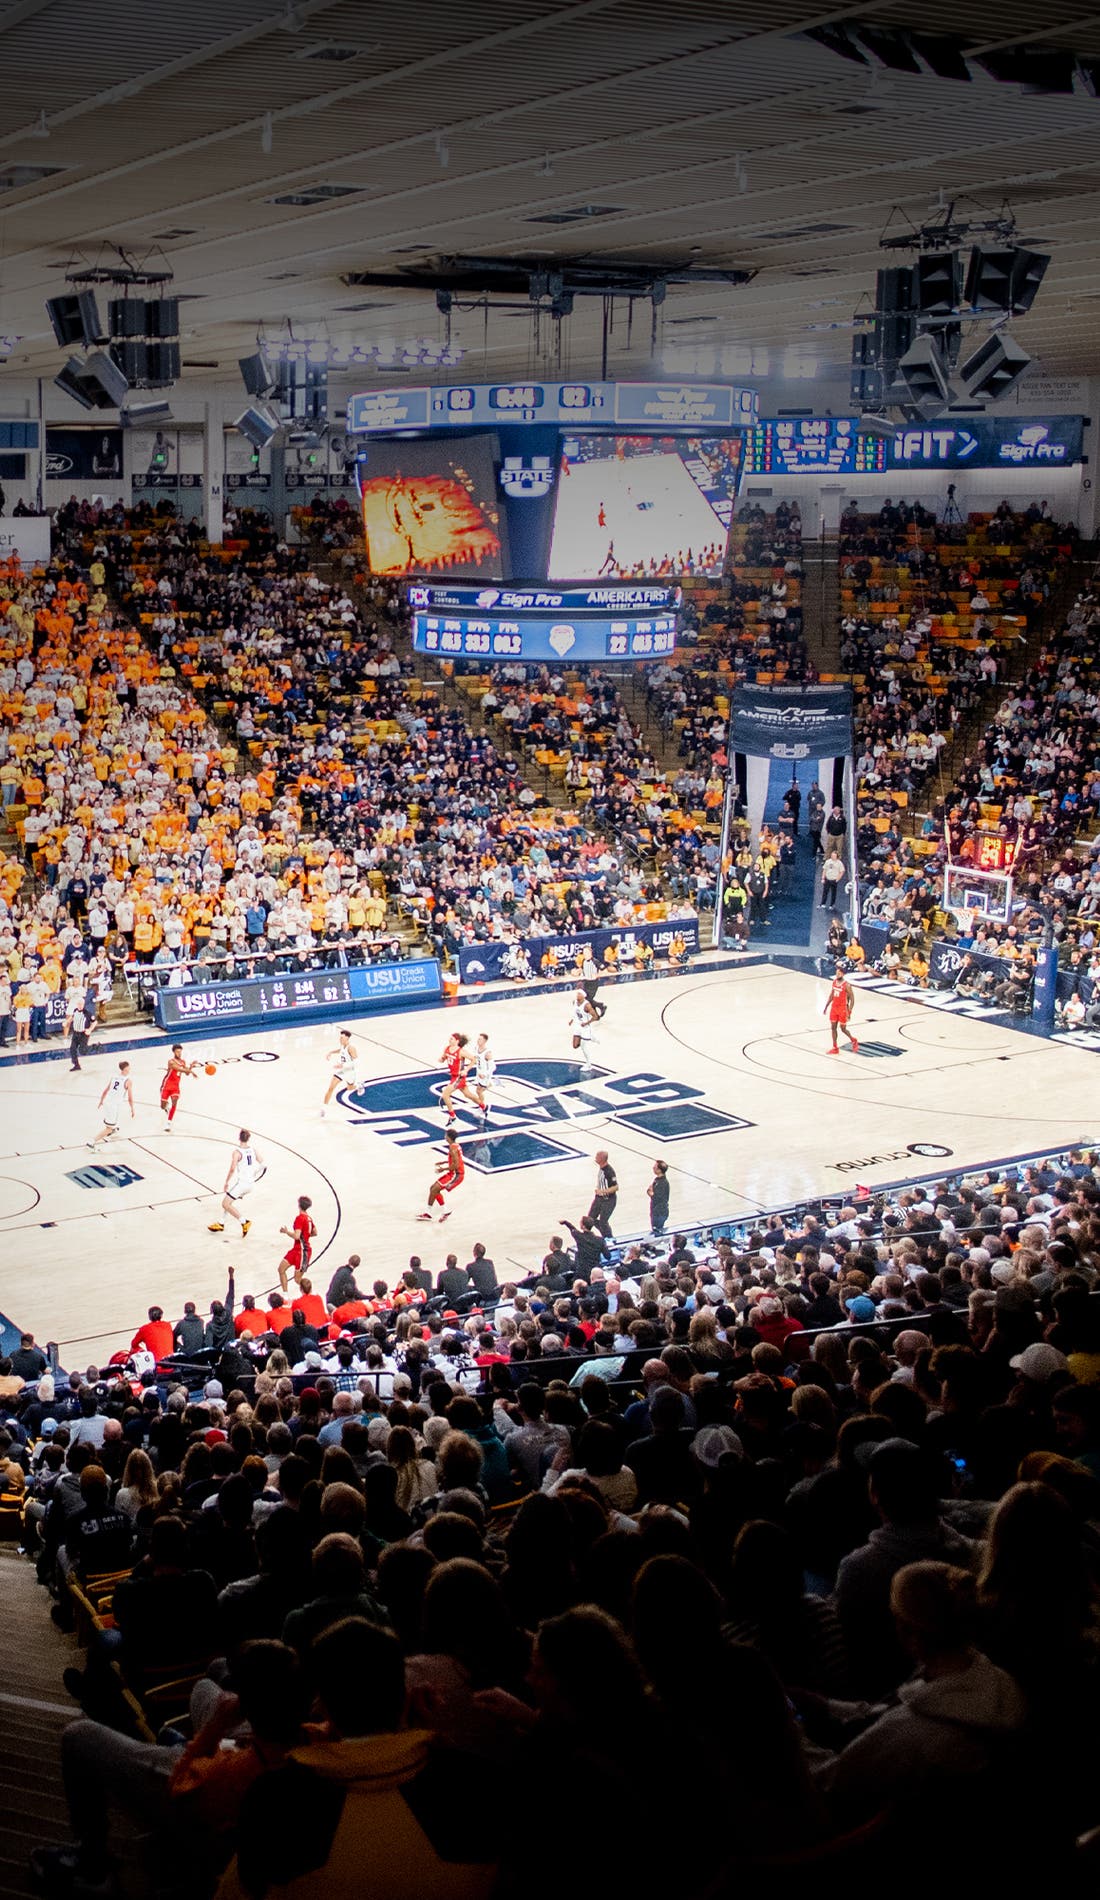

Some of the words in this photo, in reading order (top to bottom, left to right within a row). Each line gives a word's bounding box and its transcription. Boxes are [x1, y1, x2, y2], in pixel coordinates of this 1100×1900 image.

[894, 431, 955, 460] iFIT
[999, 444, 1033, 462] Sign
[1036, 444, 1066, 459] Pro
[501, 470, 553, 484] STATE
[501, 593, 535, 608] Sign
[535, 593, 563, 606] Pro
[587, 591, 643, 604] AMERICA
[643, 590, 669, 602] FIRST
[737, 709, 800, 722] AMERICA
[803, 714, 846, 723] FIRST
[366, 969, 401, 988] USU
[401, 967, 425, 976] Credit
[402, 975, 426, 984] Union
[295, 980, 315, 994] 8:44
[176, 992, 217, 1013] USU
[216, 989, 242, 1000] Credit
[217, 998, 243, 1008] Union
[113, 1080, 120, 1091] 2
[824, 1151, 912, 1174] crumbl
[102, 1515, 116, 1524] SEE
